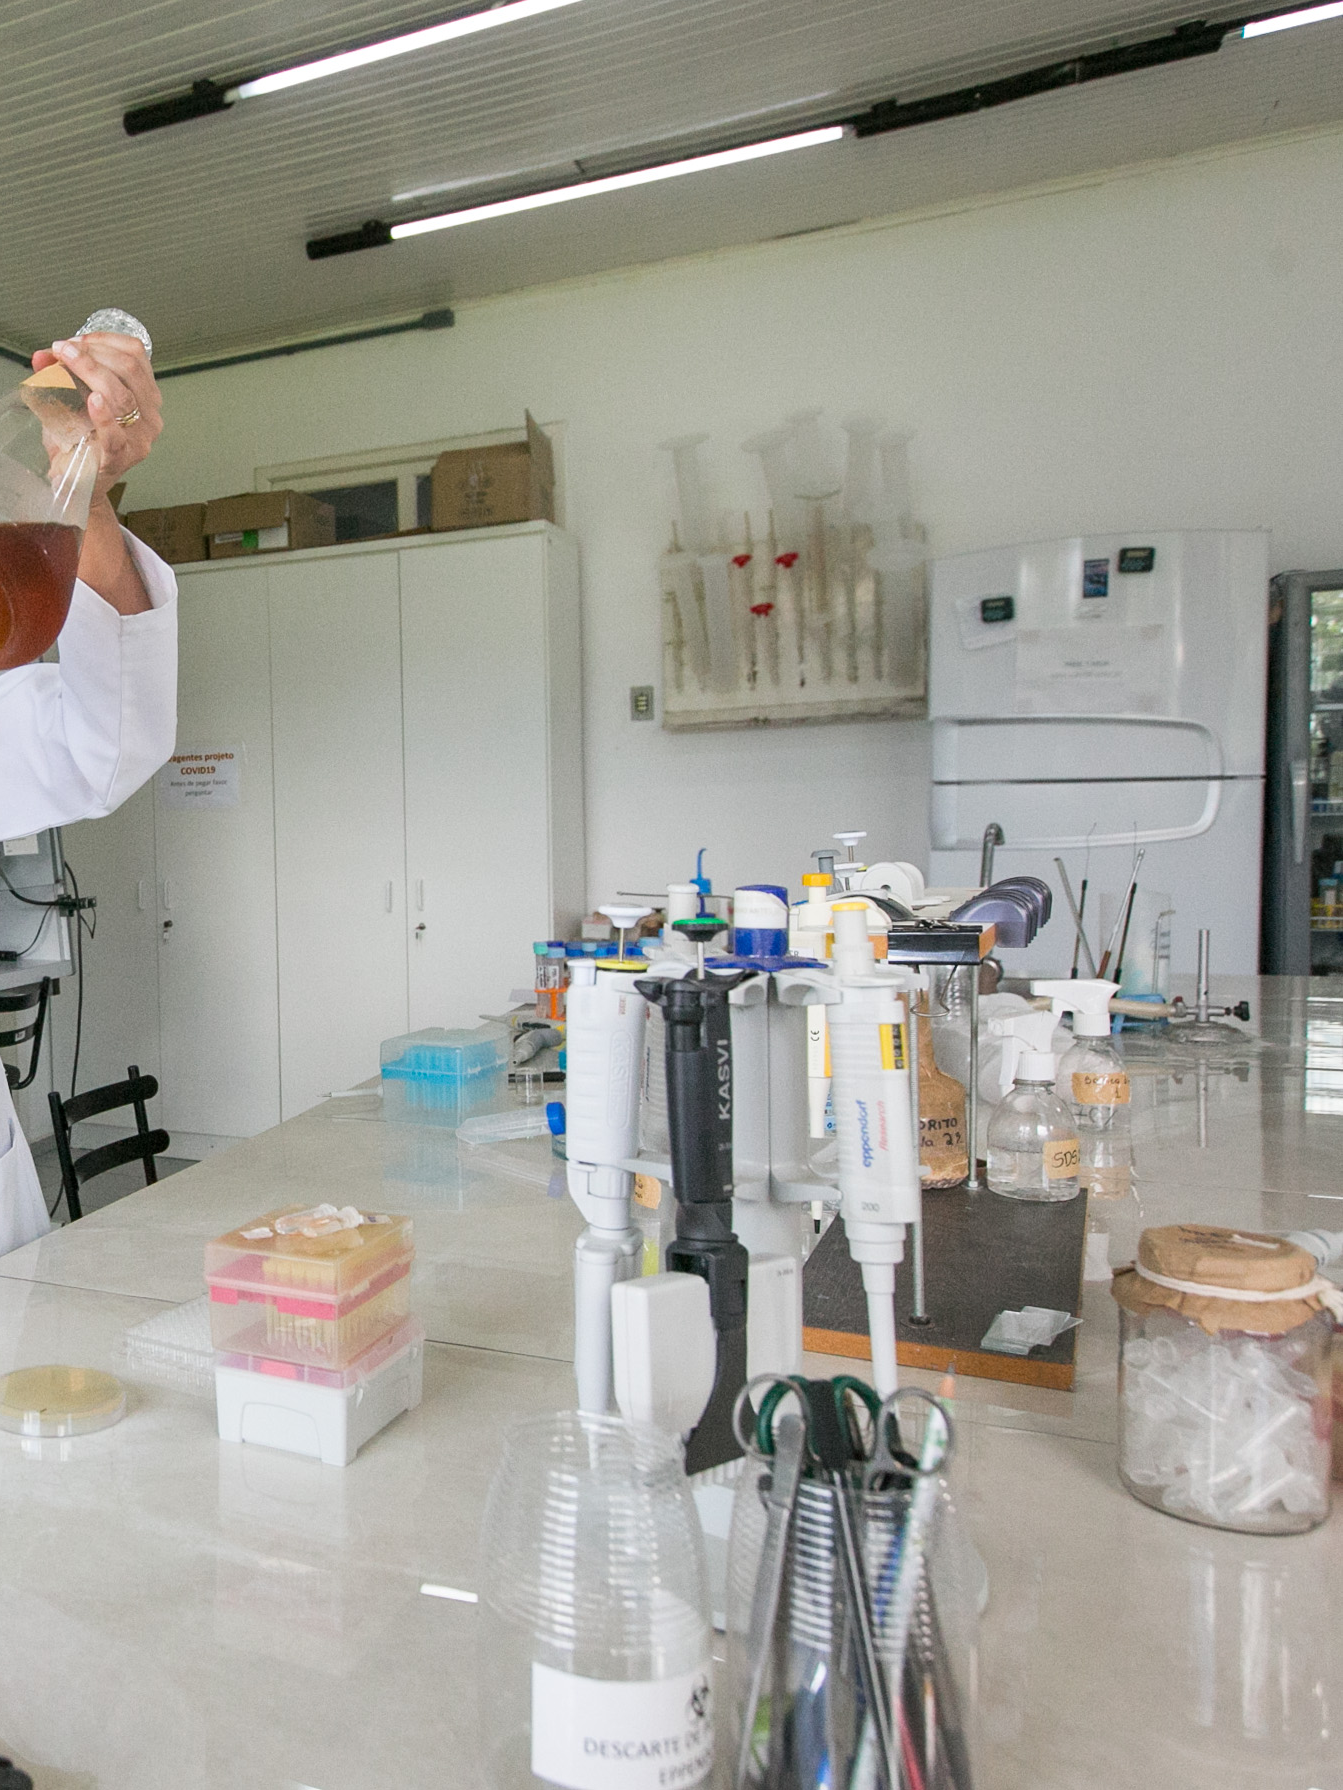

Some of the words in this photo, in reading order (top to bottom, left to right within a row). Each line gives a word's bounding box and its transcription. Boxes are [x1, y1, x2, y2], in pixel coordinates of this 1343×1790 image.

[204, 752, 234, 763] projeto
[180, 765, 216, 775] COVID19
[717, 1039, 731, 1120] KASVI
[855, 1100, 875, 1168] eppendorf
[583, 1736, 681, 1759] DESCARTE
